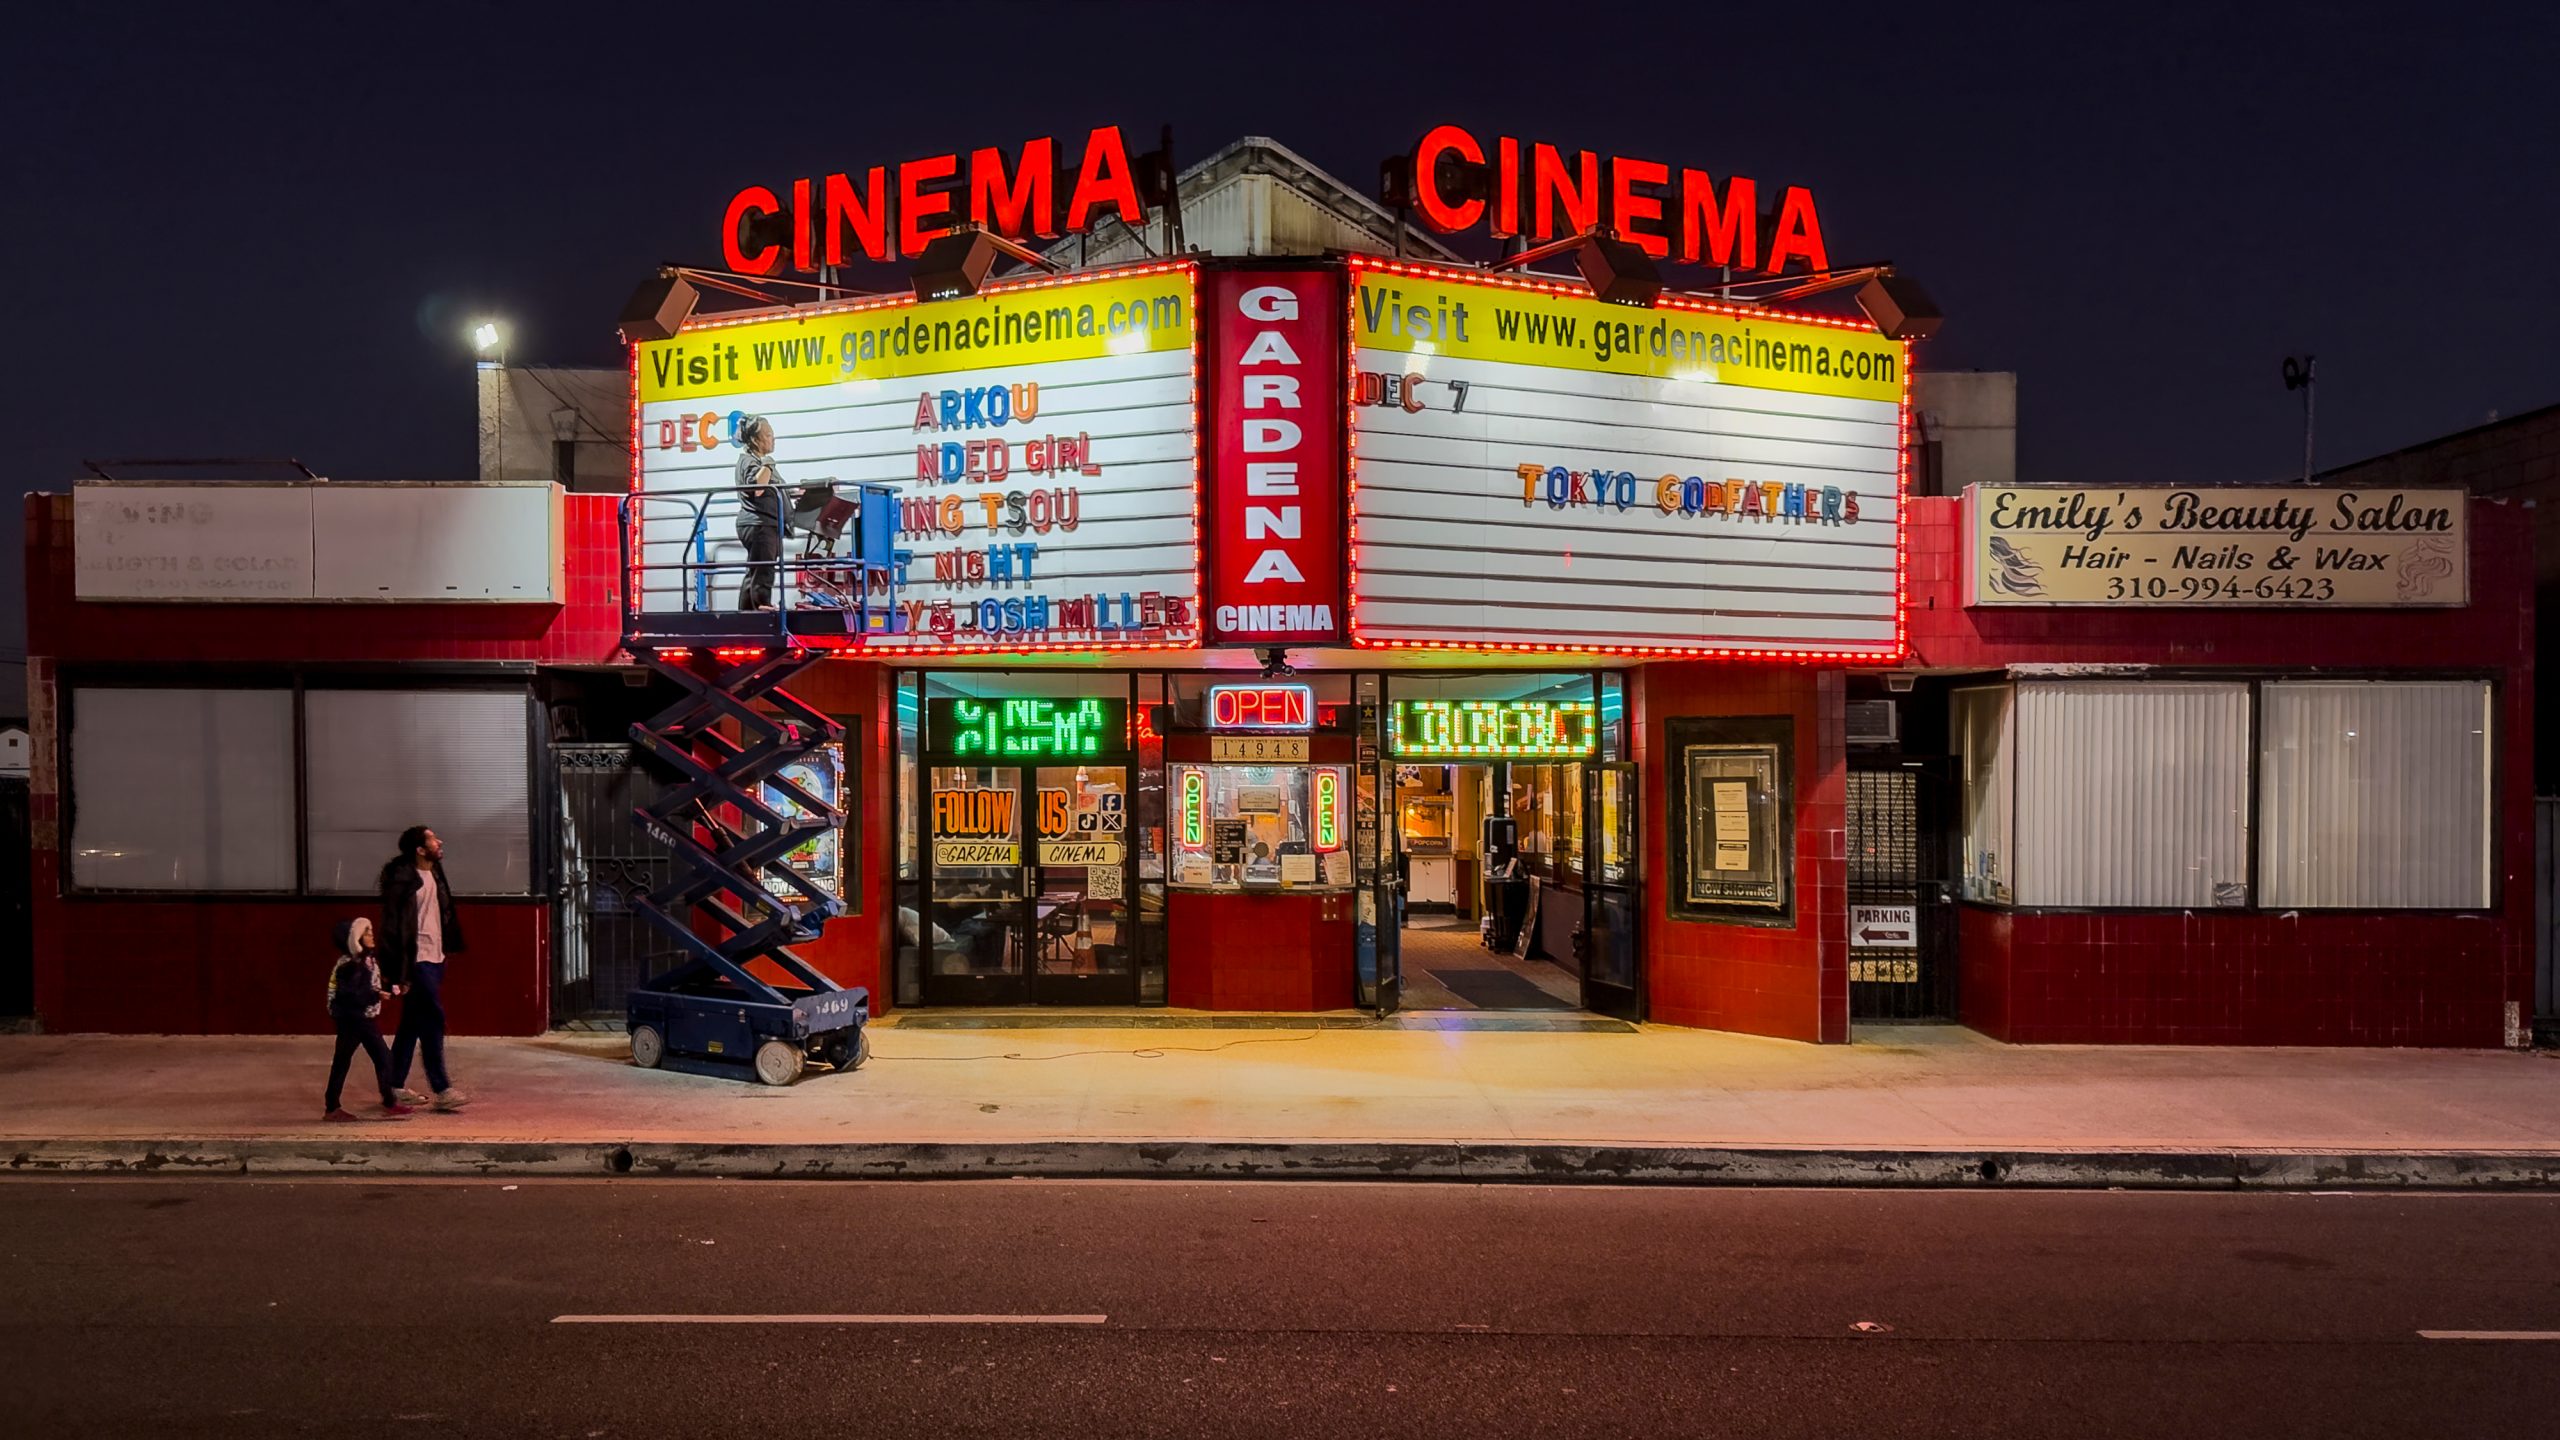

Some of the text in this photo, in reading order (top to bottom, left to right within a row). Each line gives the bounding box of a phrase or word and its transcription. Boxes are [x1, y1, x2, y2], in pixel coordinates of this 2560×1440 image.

[721, 125, 1142, 277] CINEMA
[1415, 124, 1830, 280] CINEMA
[652, 291, 1181, 388] Visit www.gardenacinema.com
[1361, 286, 1896, 383] Visit www.gardenacinema.com
[914, 382, 1039, 433] ARKOU
[1358, 372, 1469, 414] DEC 7
[660, 411, 719, 453] DEC
[1239, 286, 1305, 583] GARDENA
[917, 431, 1102, 484] NDED GIRL
[979, 487, 1079, 535] TSOU
[1517, 462, 1860, 527] TOKYO GODFATHERS
[1990, 492, 2454, 541] Emily's Beauty Salon
[936, 543, 1038, 587] NIGHT
[2061, 546, 2130, 569] Hair
[2172, 546, 2254, 570] Nails
[2267, 546, 2299, 570] &
[2317, 547, 2390, 570] Wax
[2107, 576, 2334, 600] 310-994-6423
[961, 595, 1048, 634] JOSH
[1058, 591, 1188, 632] MILLER
[1216, 605, 1333, 631] CINEMA
[1215, 690, 1306, 725] OPEN
[1222, 742, 1300, 756] 14948
[933, 790, 1068, 835] FOLLOW US
[1185, 775, 1200, 843] OPEN
[1319, 777, 1334, 844] OPEN
[938, 846, 1107, 864] @GARDENA CINEMA
[1723, 883, 1773, 897] SHOWING
[1857, 909, 1910, 923] PARKING
